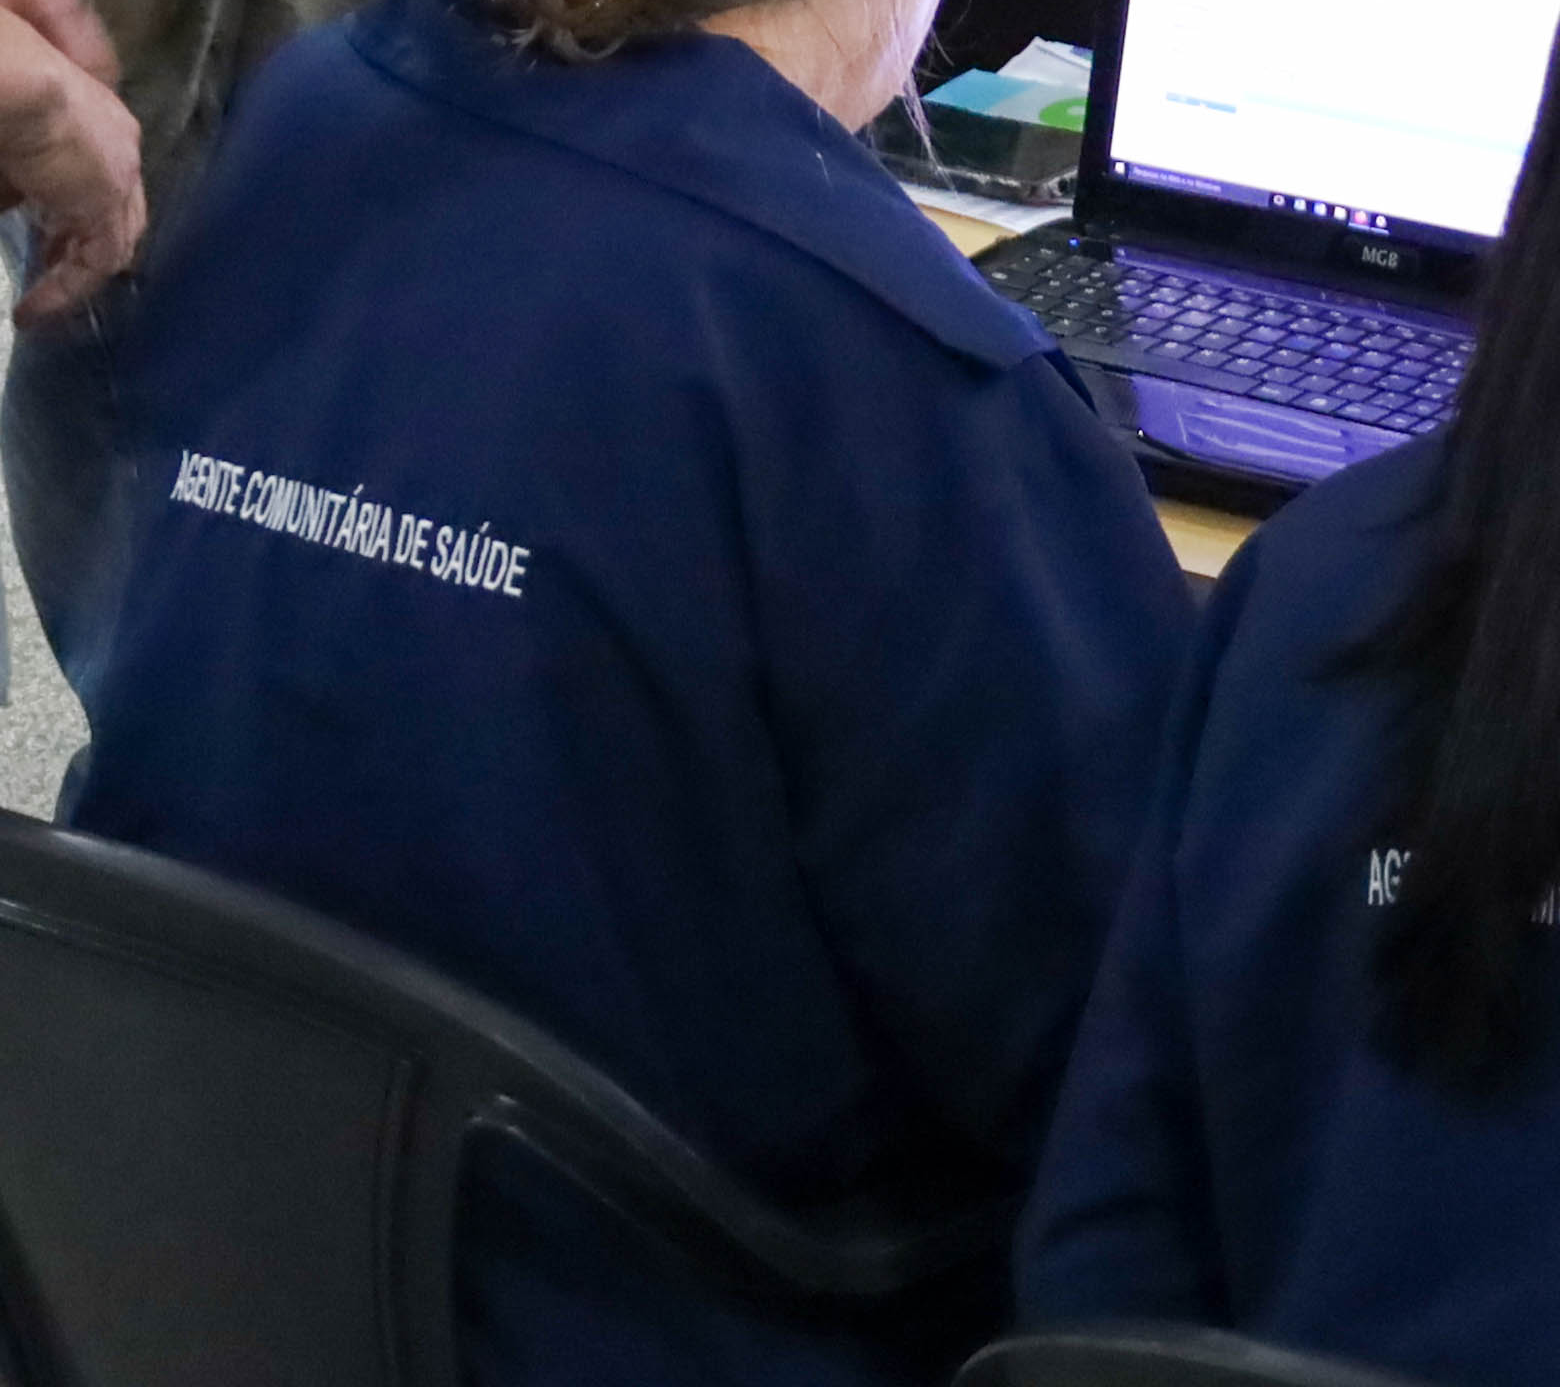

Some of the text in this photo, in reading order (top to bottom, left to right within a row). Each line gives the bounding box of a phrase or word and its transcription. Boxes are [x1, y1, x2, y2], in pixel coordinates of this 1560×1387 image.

[1361, 245, 1399, 269] MGB
[170, 449, 530, 598] AGENTE COMUNITÁRIA DE SAÚDE
